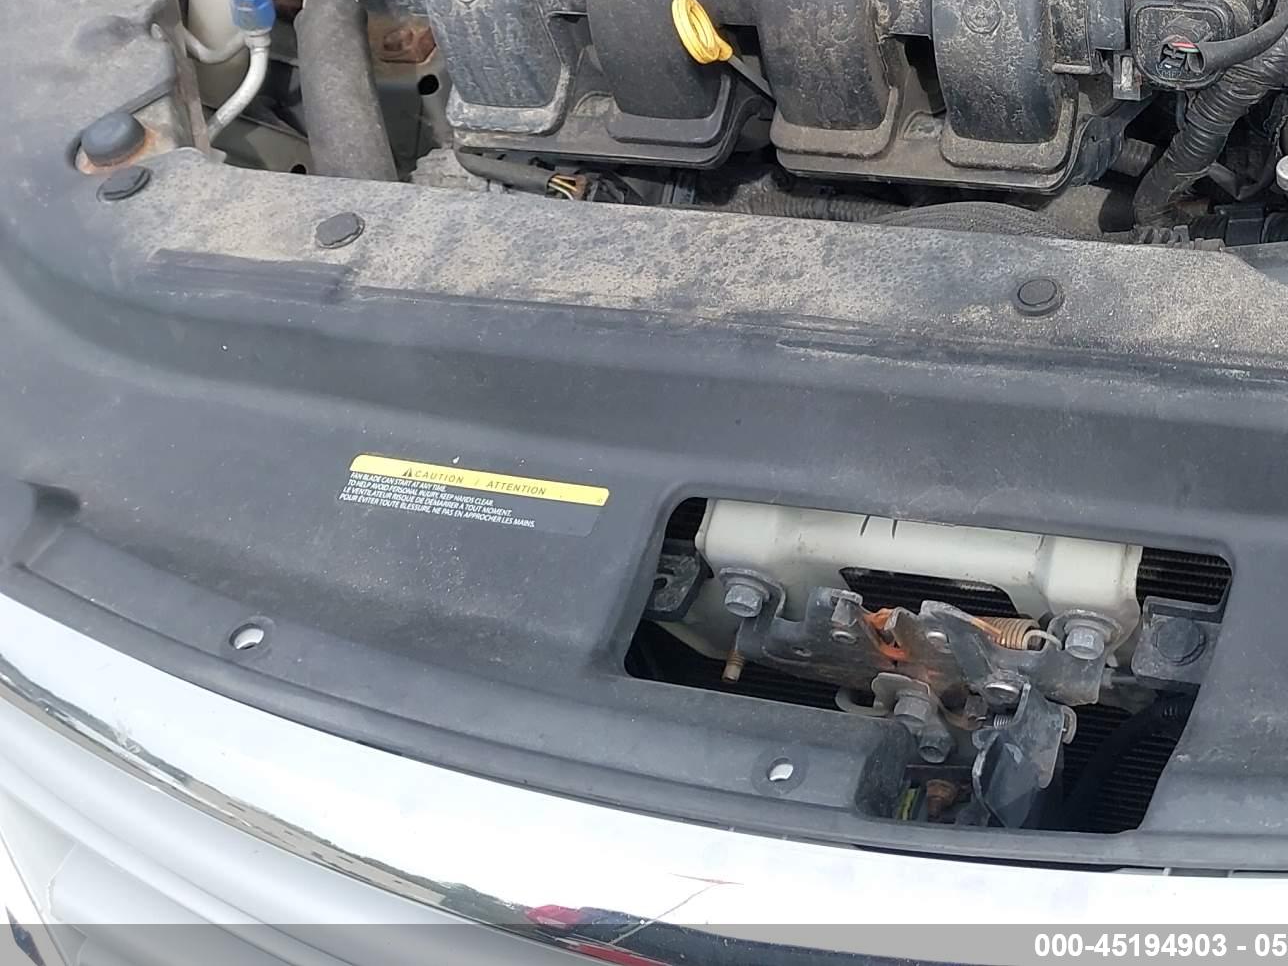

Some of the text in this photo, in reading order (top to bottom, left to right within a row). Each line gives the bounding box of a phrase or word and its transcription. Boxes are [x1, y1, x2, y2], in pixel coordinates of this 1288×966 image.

[362, 474, 380, 482] BLADE
[381, 476, 394, 484] CAN
[414, 470, 464, 483] CAUTION
[486, 481, 546, 495] ATTENTION
[352, 488, 392, 499] VENTILATEUR
[392, 493, 415, 502] RISQUE
[465, 504, 482, 512] TOUT
[356, 480, 372, 488] HELP
[389, 485, 418, 496] PERSONAL
[454, 495, 474, 503] HANDS
[339, 493, 358, 501] POUR
[379, 499, 400, 508] TOUTE
[463, 512, 501, 522] APPROCHER
